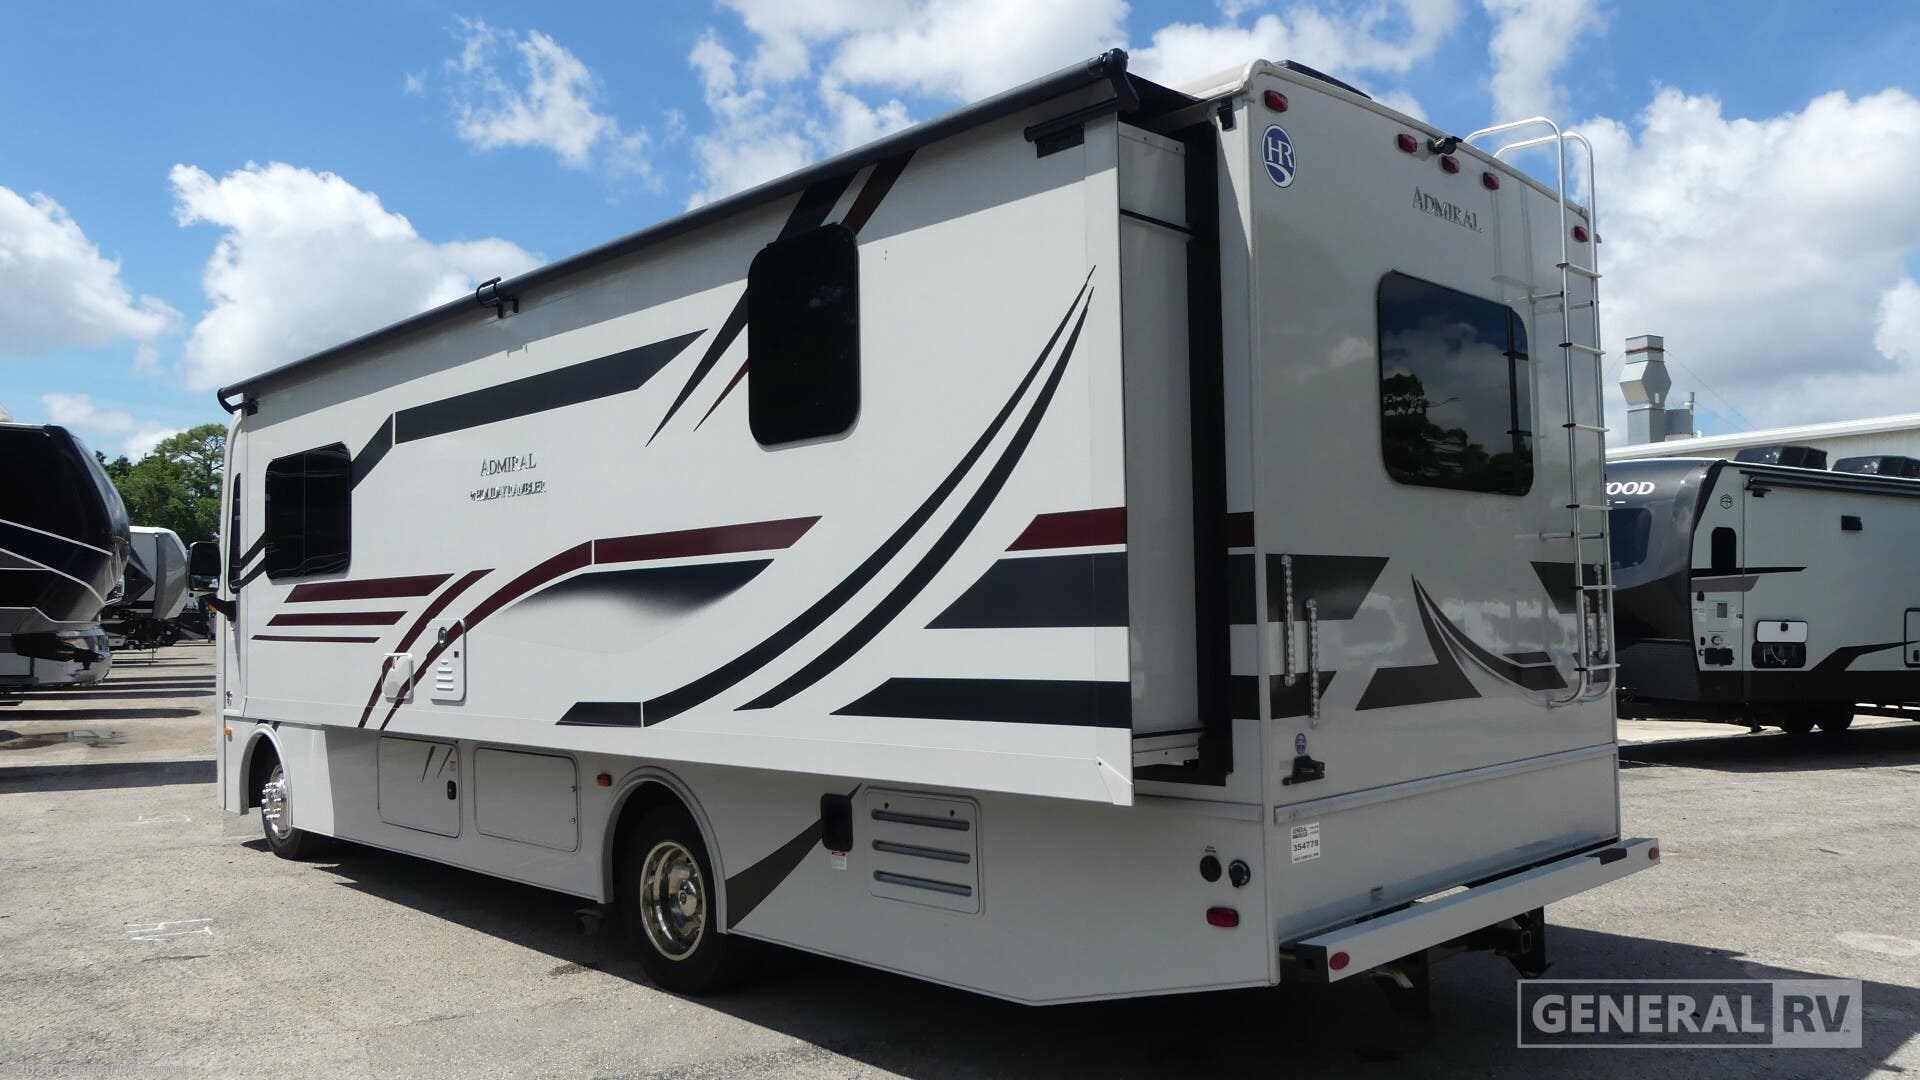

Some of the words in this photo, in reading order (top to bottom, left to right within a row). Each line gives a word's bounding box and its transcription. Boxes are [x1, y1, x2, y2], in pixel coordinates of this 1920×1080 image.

[1267, 136, 1293, 168] HR
[1412, 184, 1483, 233] ADMIRAL
[480, 453, 537, 477] ADMIRAL
[1606, 481, 1655, 495] OOD
